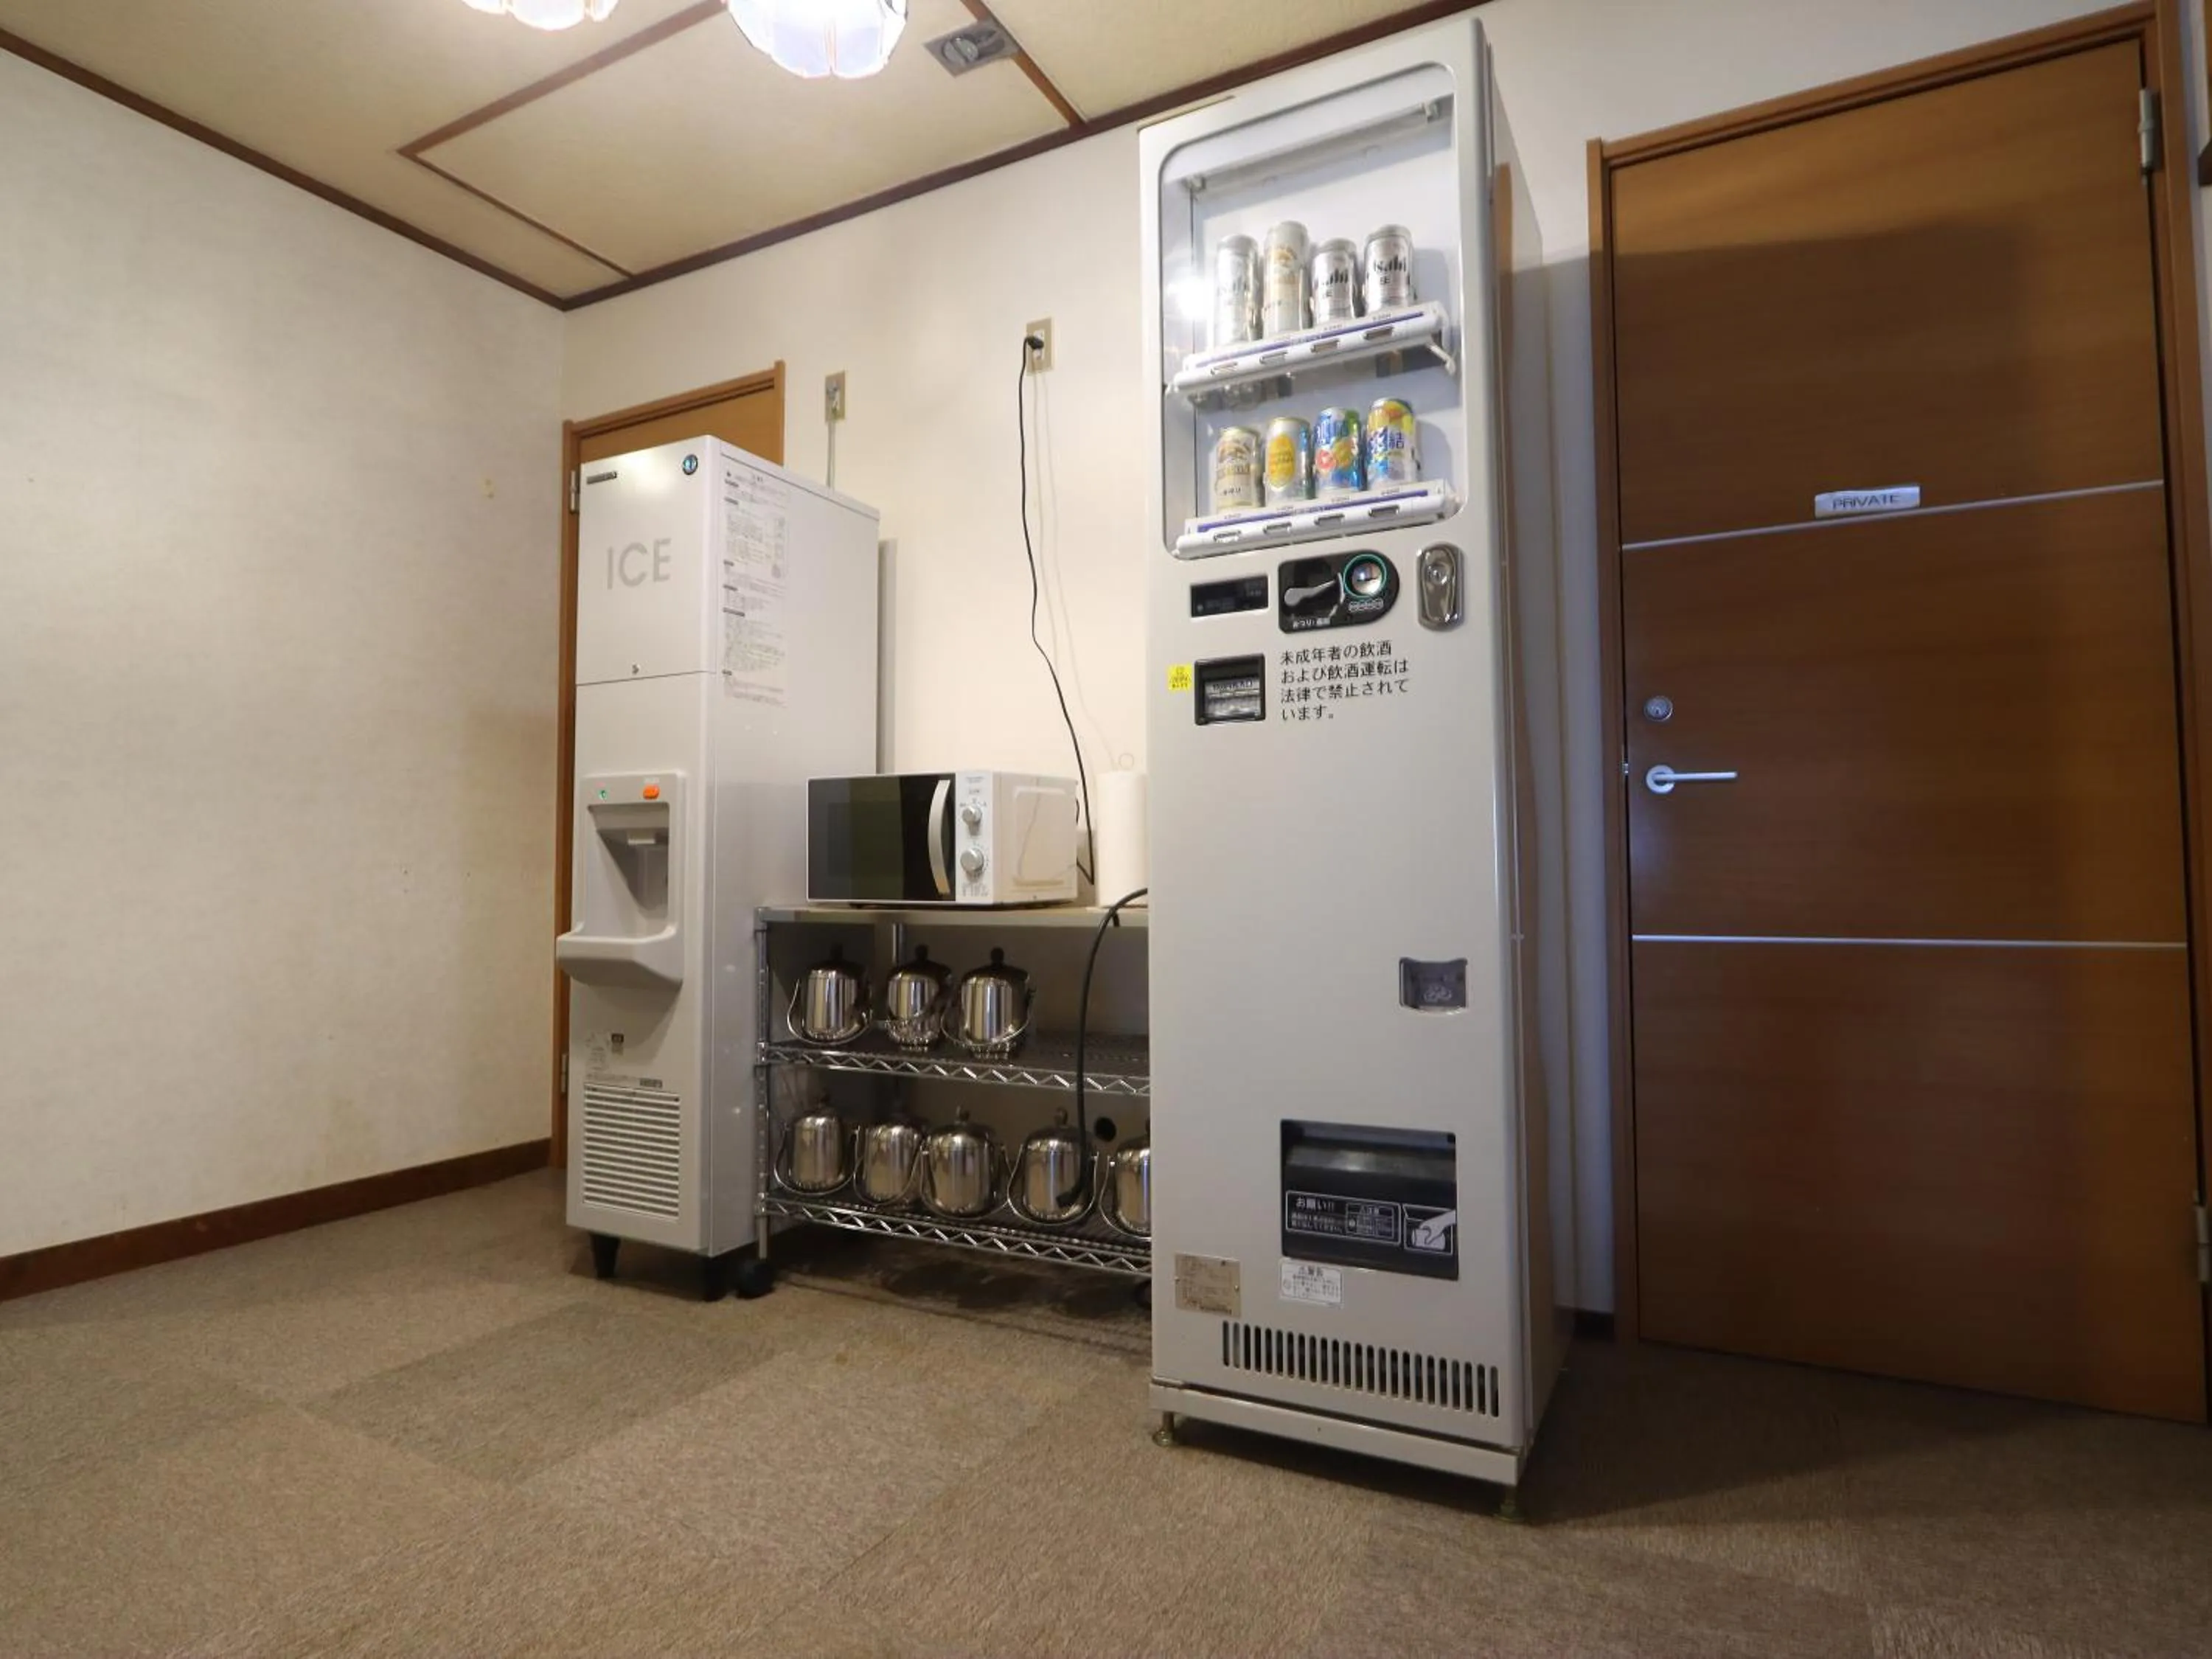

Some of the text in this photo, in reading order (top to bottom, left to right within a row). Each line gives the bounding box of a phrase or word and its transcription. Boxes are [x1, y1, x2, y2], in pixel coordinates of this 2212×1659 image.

[1832, 493, 1901, 510] PRIVATE
[606, 538, 672, 590] ICE
[1281, 639, 1392, 665] 未成年者の飲酒
[1281, 658, 1408, 684] および飲酒運転は
[1281, 678, 1409, 703] 法律で禁止されて
[1281, 704, 1334, 720] います。
